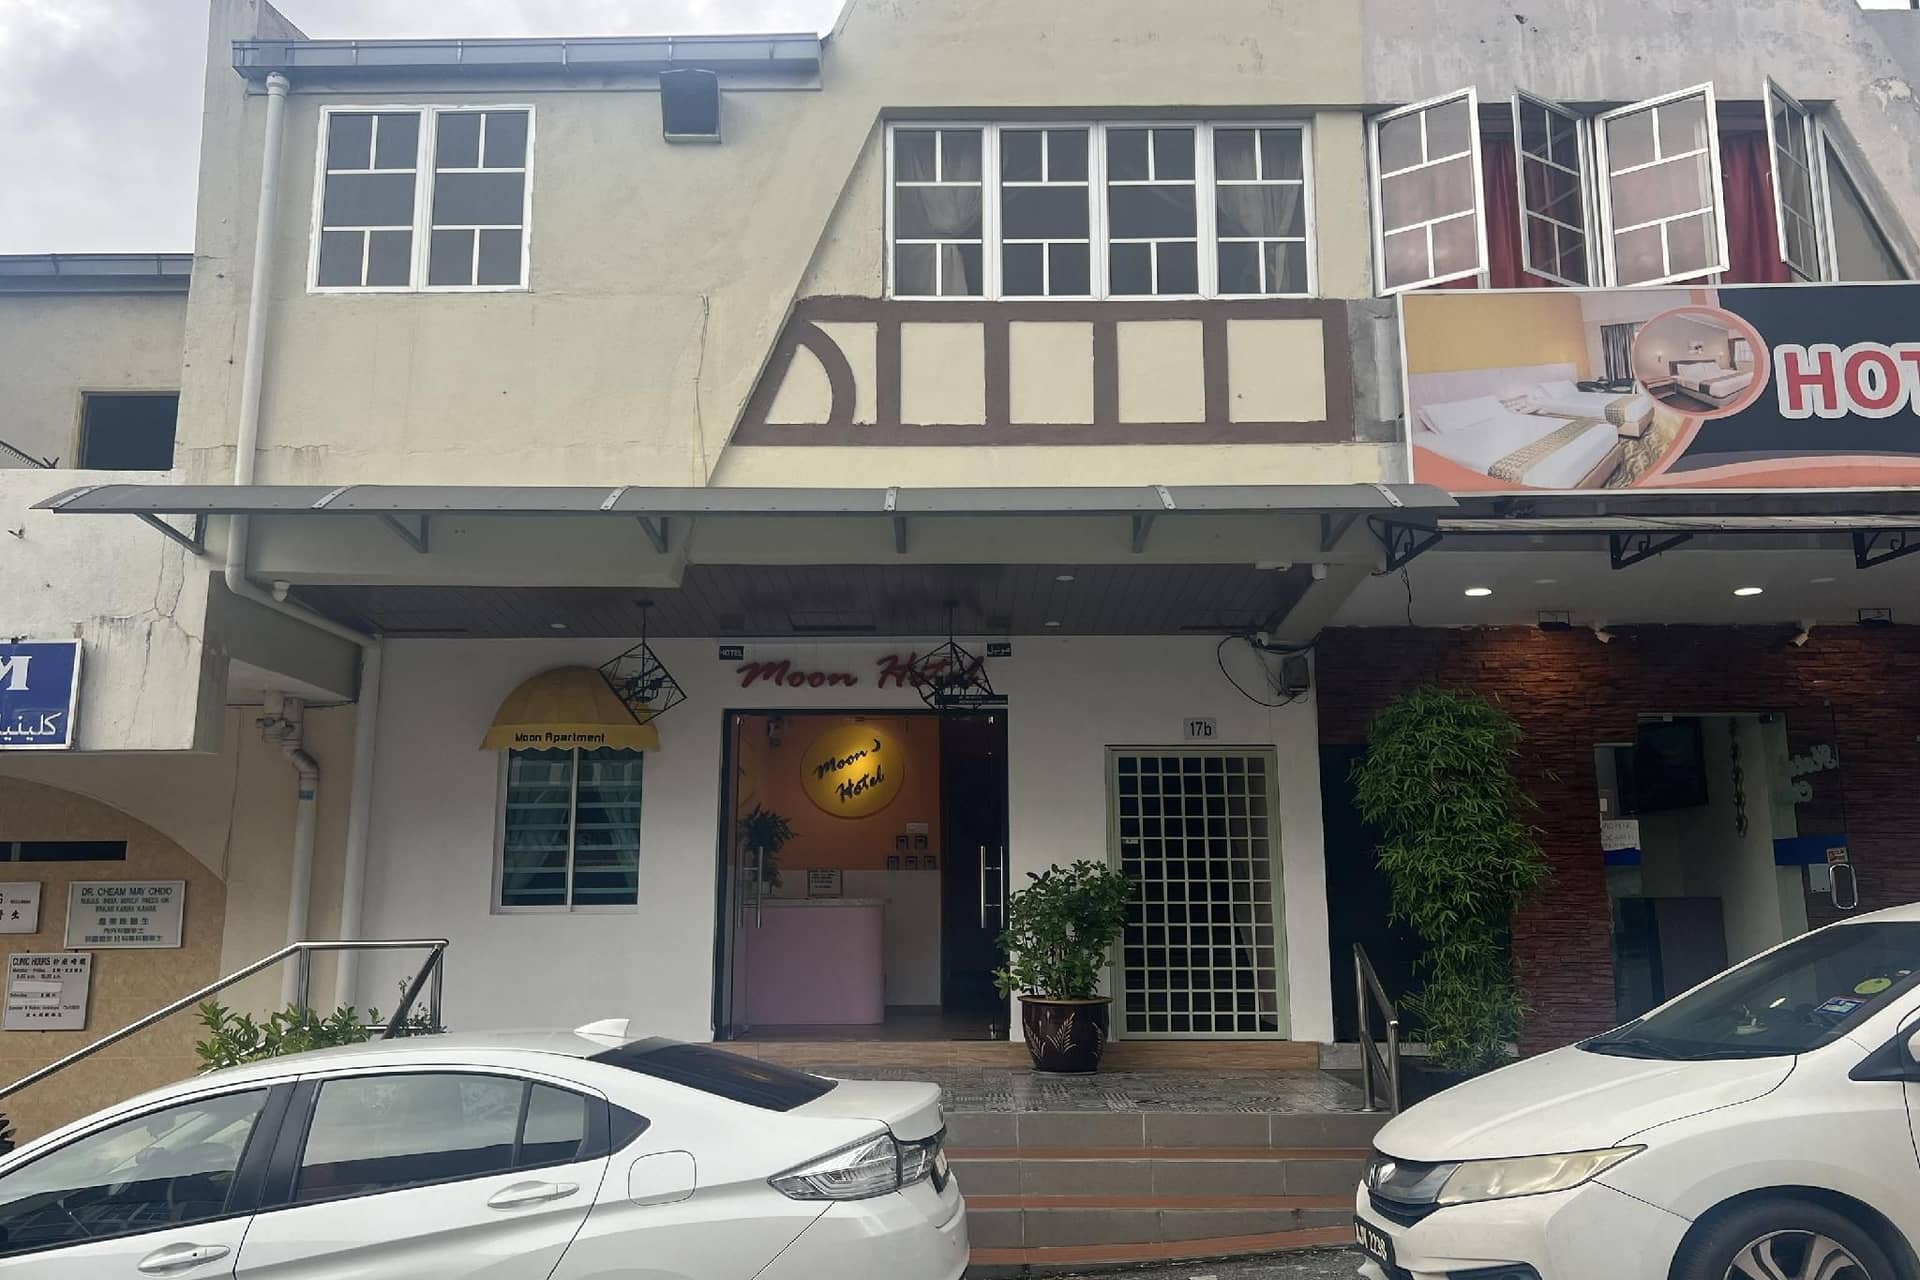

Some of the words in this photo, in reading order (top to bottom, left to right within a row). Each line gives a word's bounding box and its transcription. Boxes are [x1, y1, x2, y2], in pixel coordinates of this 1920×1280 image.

[736, 659, 858, 688] Moon
[876, 652, 985, 688] Hotl
[515, 732, 542, 742] Moon
[545, 732, 605, 743] Apartment
[1190, 720, 1212, 736] 17b
[813, 750, 868, 779] Moon
[834, 764, 884, 804] Hotel
[129, 888, 145, 896] MAY
